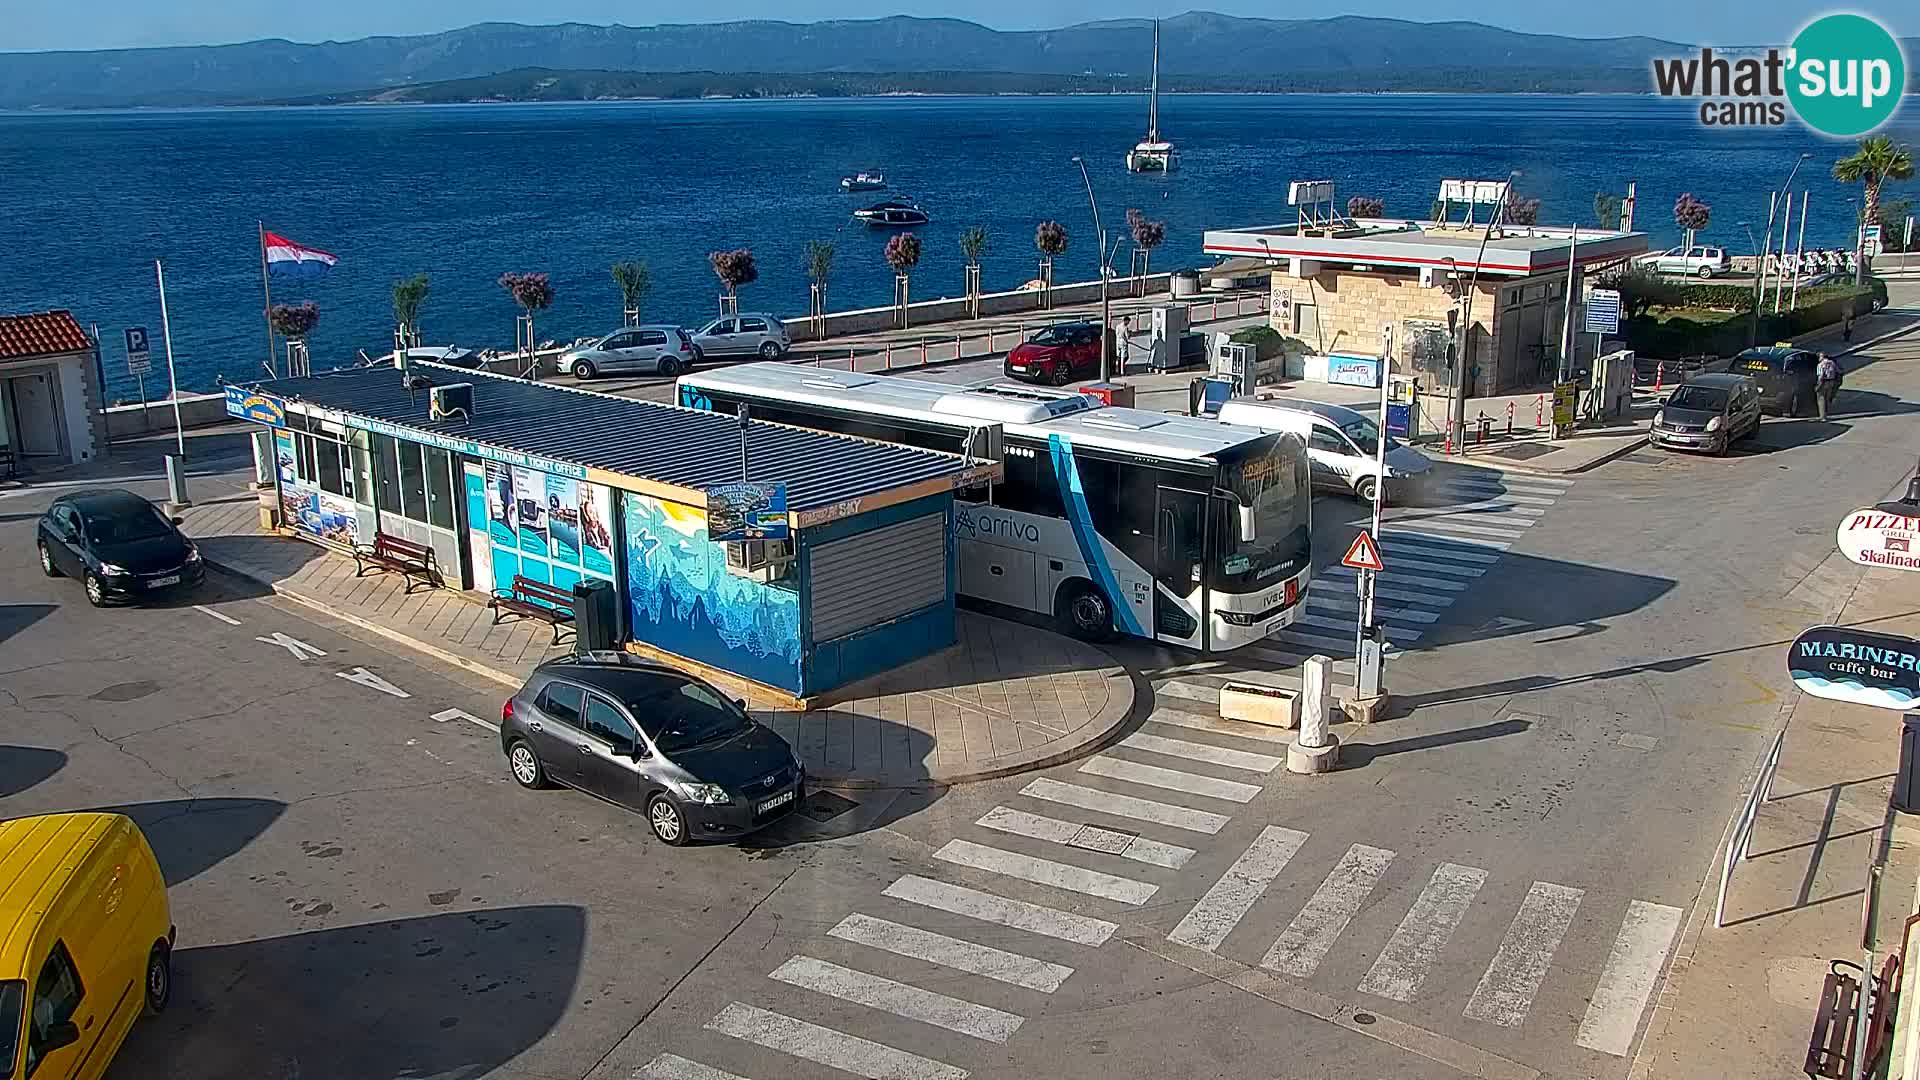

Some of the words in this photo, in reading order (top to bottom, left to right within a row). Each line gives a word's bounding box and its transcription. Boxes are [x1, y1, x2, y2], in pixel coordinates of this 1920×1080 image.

[130, 331, 143, 349] P
[493, 449, 526, 464] STATION
[527, 456, 555, 471] TICKET
[556, 462, 583, 477] OFFICE
[978, 514, 1040, 543] arriva
[1881, 529, 1917, 540] GRILL
[1263, 591, 1284, 607] IVEC
[1829, 660, 1866, 676] caffe
[1870, 665, 1897, 680] bar
